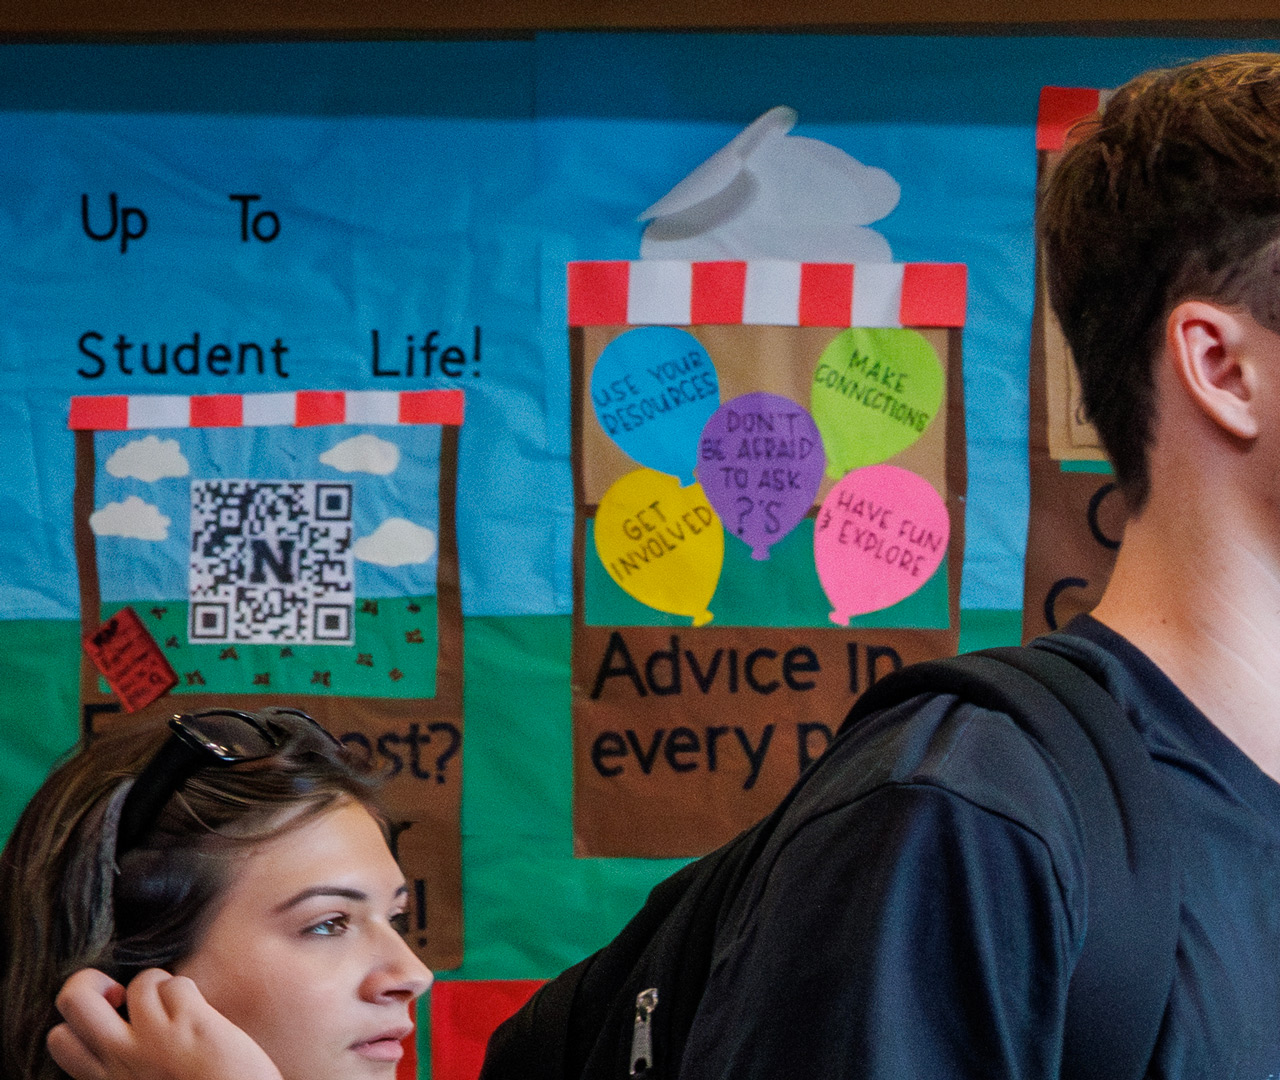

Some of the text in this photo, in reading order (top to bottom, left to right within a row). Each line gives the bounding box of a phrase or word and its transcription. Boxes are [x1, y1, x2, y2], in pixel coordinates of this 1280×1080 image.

[81, 193, 281, 254] Up To
[77, 326, 482, 379] Student Life!
[595, 351, 703, 406] USE YOUR
[848, 349, 908, 394] MAKE
[602, 371, 719, 435] RESOURCES
[727, 410, 799, 435] DON'T
[814, 363, 930, 433] CONNECTIONS
[702, 437, 813, 461] BE AFRAID
[720, 466, 801, 491] TO ASK
[610, 505, 713, 581] INVOLVED
[622, 500, 667, 540] GET
[837, 490, 943, 552] HAVE FUN
[838, 519, 925, 577] EXPLORE
[590, 631, 820, 700] Advice
[590, 722, 776, 790] every
